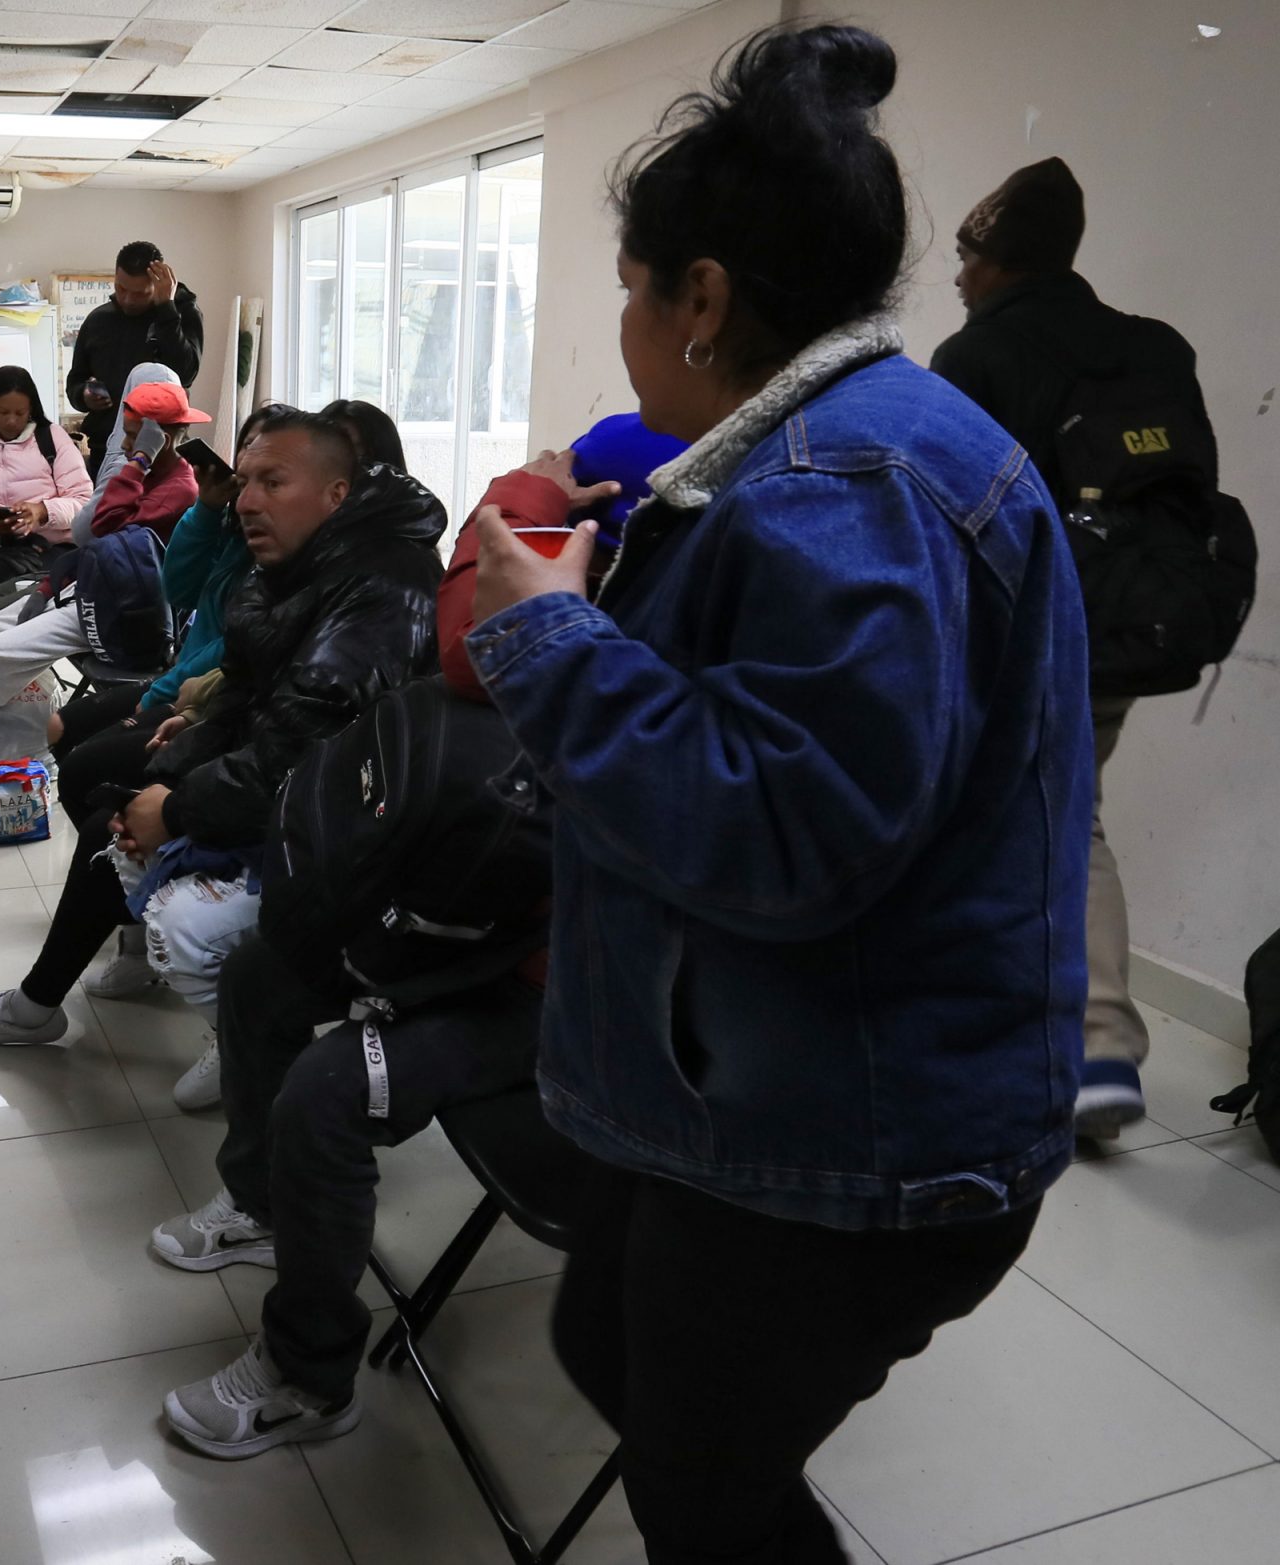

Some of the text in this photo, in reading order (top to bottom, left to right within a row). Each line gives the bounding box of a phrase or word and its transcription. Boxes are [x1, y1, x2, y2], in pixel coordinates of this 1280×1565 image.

[1123, 427, 1170, 454] CAT
[81, 598, 114, 663] EVERLAST
[0, 794, 33, 808] LAZA
[364, 1024, 382, 1065] GAO
